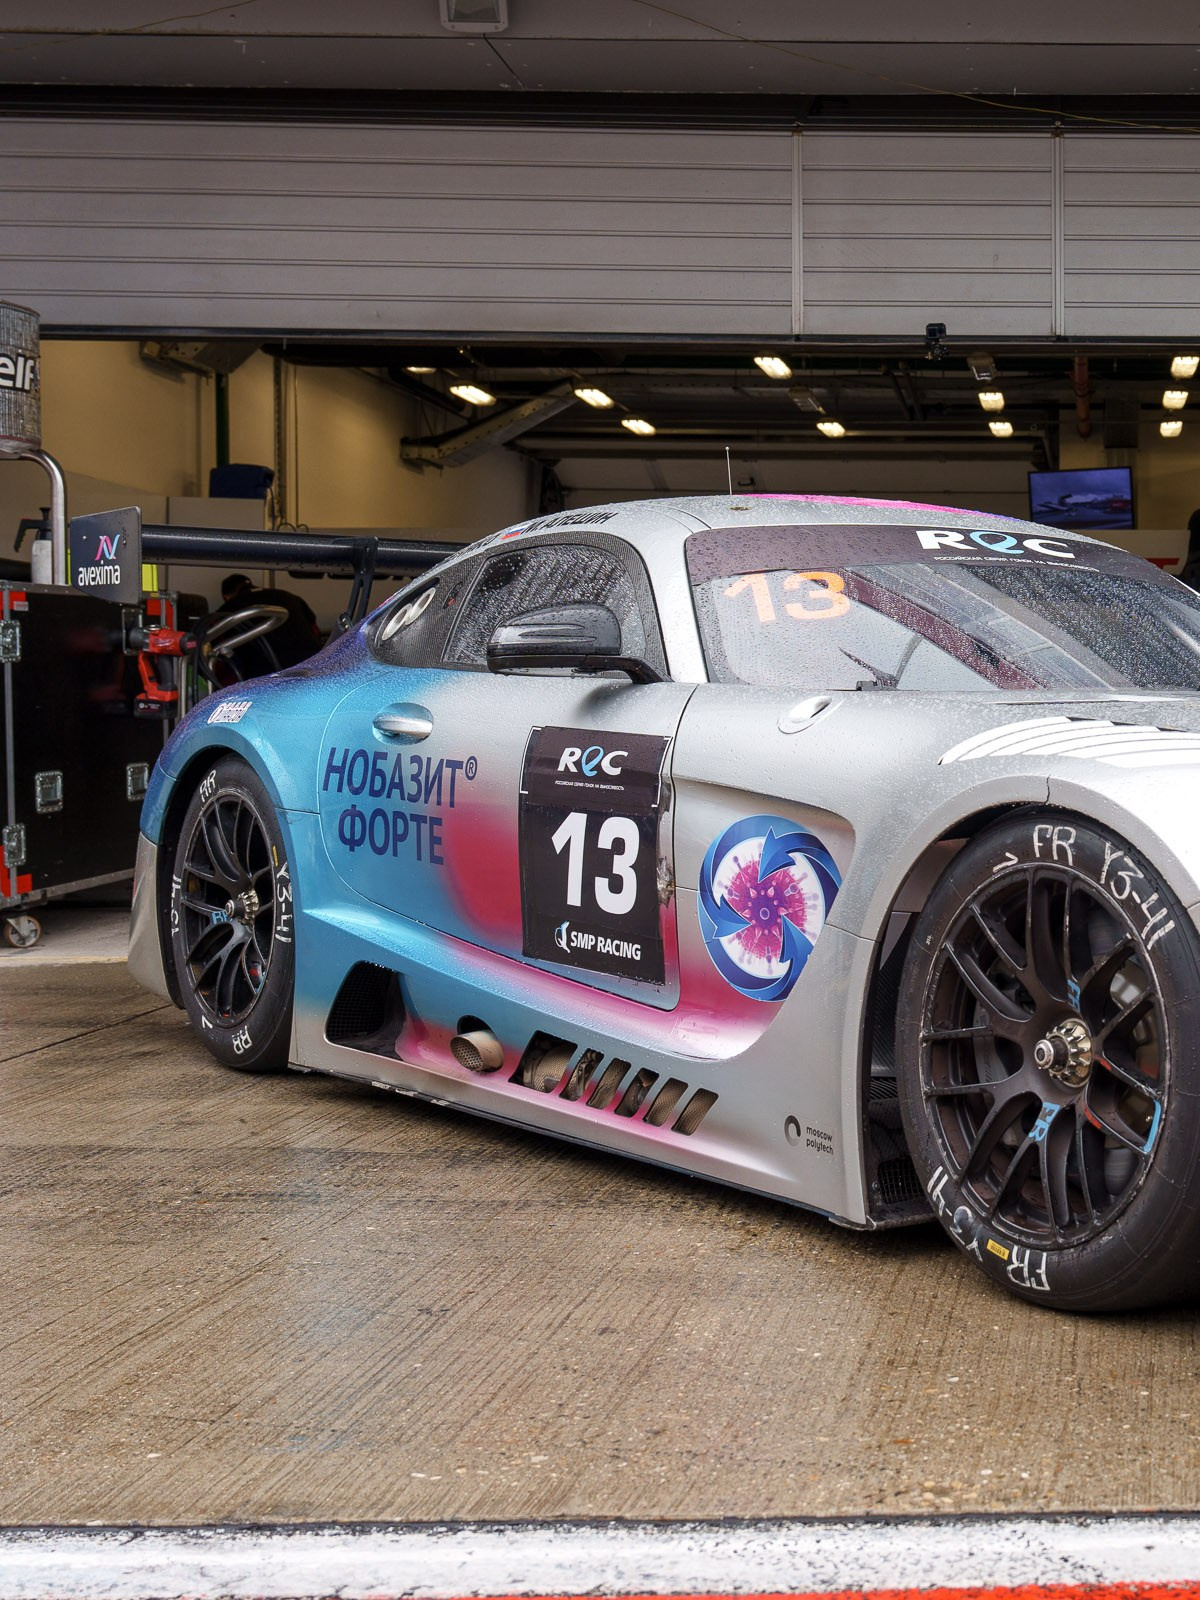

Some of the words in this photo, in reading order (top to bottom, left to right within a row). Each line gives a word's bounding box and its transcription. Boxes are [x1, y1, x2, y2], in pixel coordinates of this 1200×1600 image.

[78, 560, 121, 586] avexima
[723, 571, 851, 623] 13
[338, 804, 444, 865] ФОРТЕ
[1033, 824, 1077, 866] FR
[551, 812, 640, 915] 13
[570, 931, 596, 950] SMP
[596, 936, 642, 961] RACING
[806, 1126, 833, 1142] moscow
[806, 1139, 834, 1155] polytech
